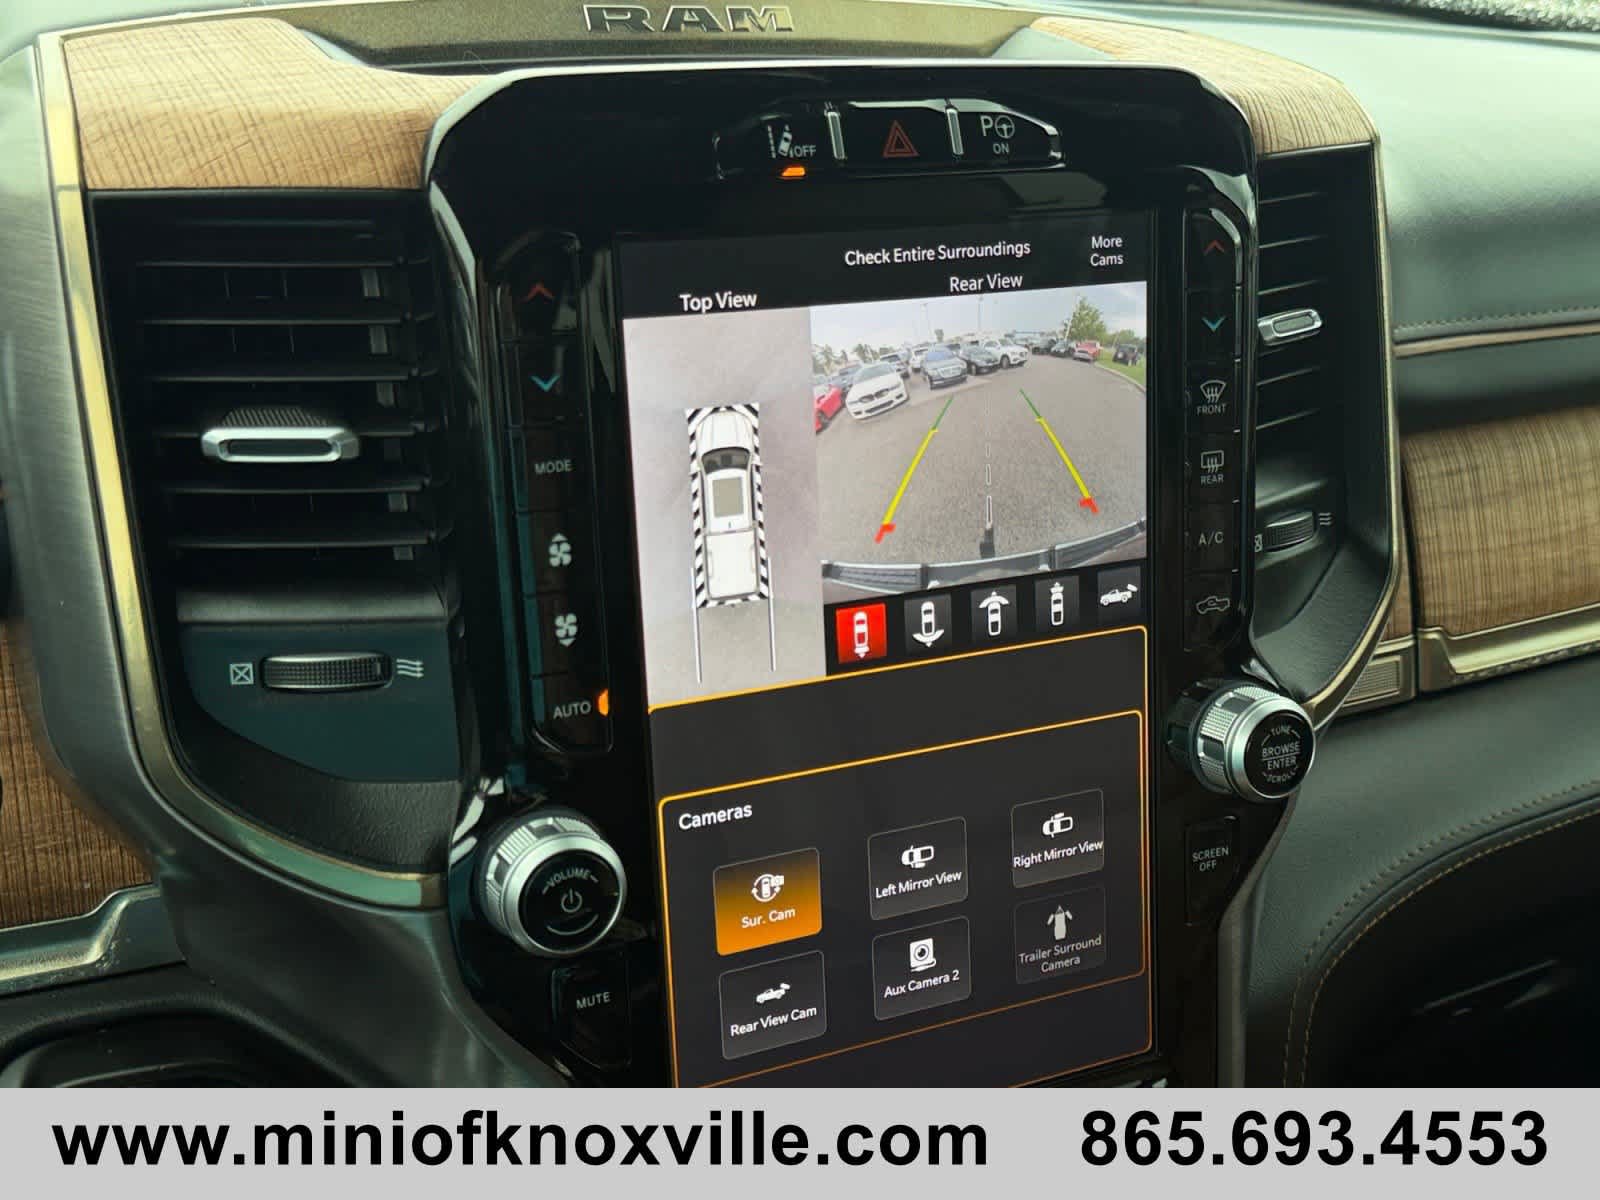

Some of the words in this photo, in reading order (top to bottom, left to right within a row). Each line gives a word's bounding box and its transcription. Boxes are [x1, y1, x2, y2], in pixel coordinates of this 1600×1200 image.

[583, 3, 794, 34] RAM
[794, 143, 817, 158] OFF
[992, 142, 1010, 155] ON
[1091, 235, 1123, 249] More
[845, 247, 891, 267] Check
[893, 245, 935, 263] Entire
[937, 239, 1031, 262] Surroundings
[1090, 252, 1124, 267] Cams
[949, 275, 984, 292] Rear
[984, 272, 1023, 290] View
[680, 293, 713, 314] Top
[715, 291, 758, 309] View
[1196, 403, 1228, 416] FRONT
[535, 459, 573, 475] MODE
[1200, 473, 1225, 485] REAR
[1198, 531, 1225, 546] A/C
[552, 701, 592, 720] AUTO
[1271, 725, 1292, 737] TUNE
[1261, 742, 1301, 757] BROWSE
[1266, 756, 1298, 771] ENTER
[1266, 770, 1297, 784] SCROLL
[678, 802, 754, 831] Cameras
[1012, 850, 1042, 870] Right
[1043, 845, 1077, 864] Mirror
[1077, 838, 1105, 857] View
[1192, 847, 1230, 863] SCREEN
[1199, 860, 1218, 872] OFF
[547, 867, 591, 888] VOLUME
[875, 882, 897, 899] Left
[898, 875, 934, 895] Mirror
[934, 869, 963, 887] View
[741, 912, 767, 929] Sur.
[767, 906, 796, 923] Cam
[1018, 944, 1051, 964] Trailer
[1052, 935, 1102, 958] Surround
[1040, 954, 1081, 974] Camera
[883, 982, 905, 998] Aux
[907, 974, 950, 994] Camera
[951, 969, 960, 983] 2
[576, 991, 612, 1010] MUTE
[730, 1020, 759, 1037] Rear
[759, 1012, 789, 1031] View
[790, 1004, 818, 1022] Cam
